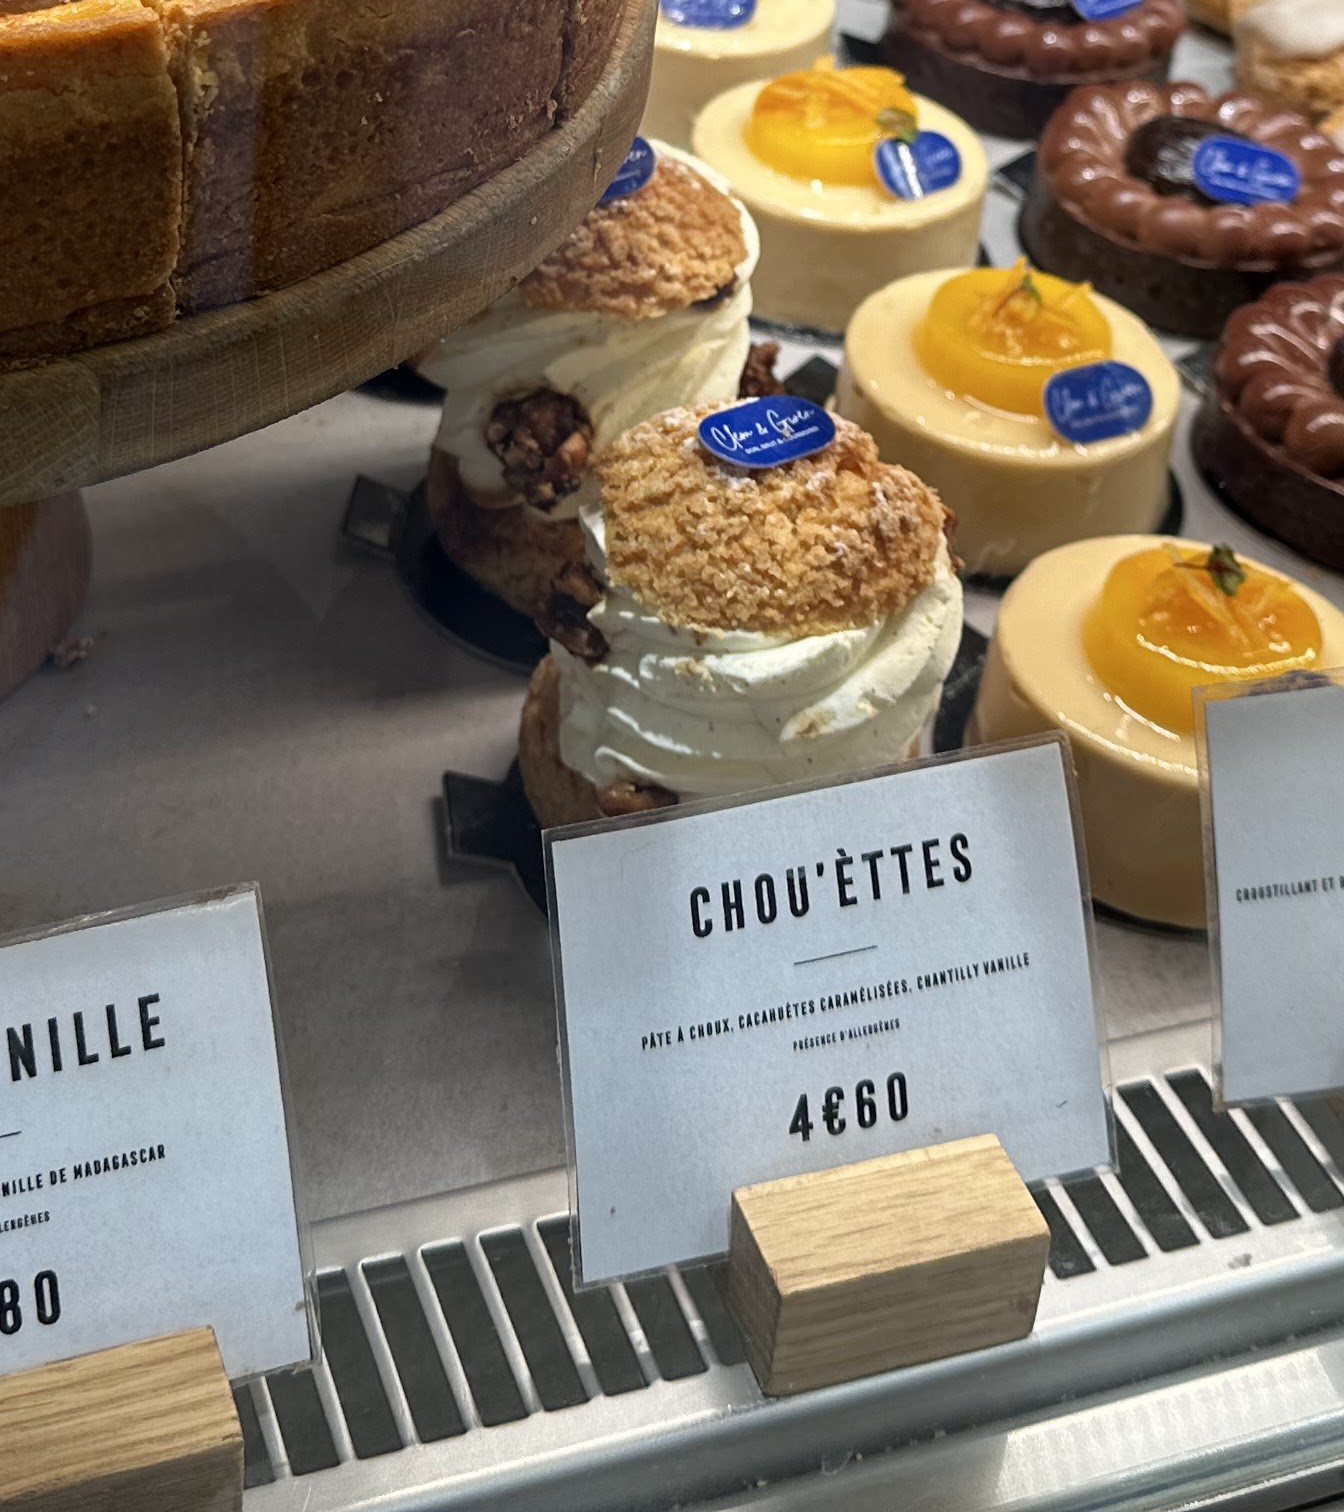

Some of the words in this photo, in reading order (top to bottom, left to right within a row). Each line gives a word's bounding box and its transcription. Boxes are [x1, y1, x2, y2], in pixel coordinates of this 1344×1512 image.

[688, 832, 973, 939] CHOU'ÈTTES
[640, 1029, 673, 1052] PÂTE
[676, 1025, 686, 1044] À
[915, 963, 980, 991] CHANTILLY
[982, 951, 1031, 976] VANILLE
[789, 1071, 909, 1142] 4€60
[48, 1166, 68, 1187] DE
[72, 1143, 166, 1181] MADAGASCAR
